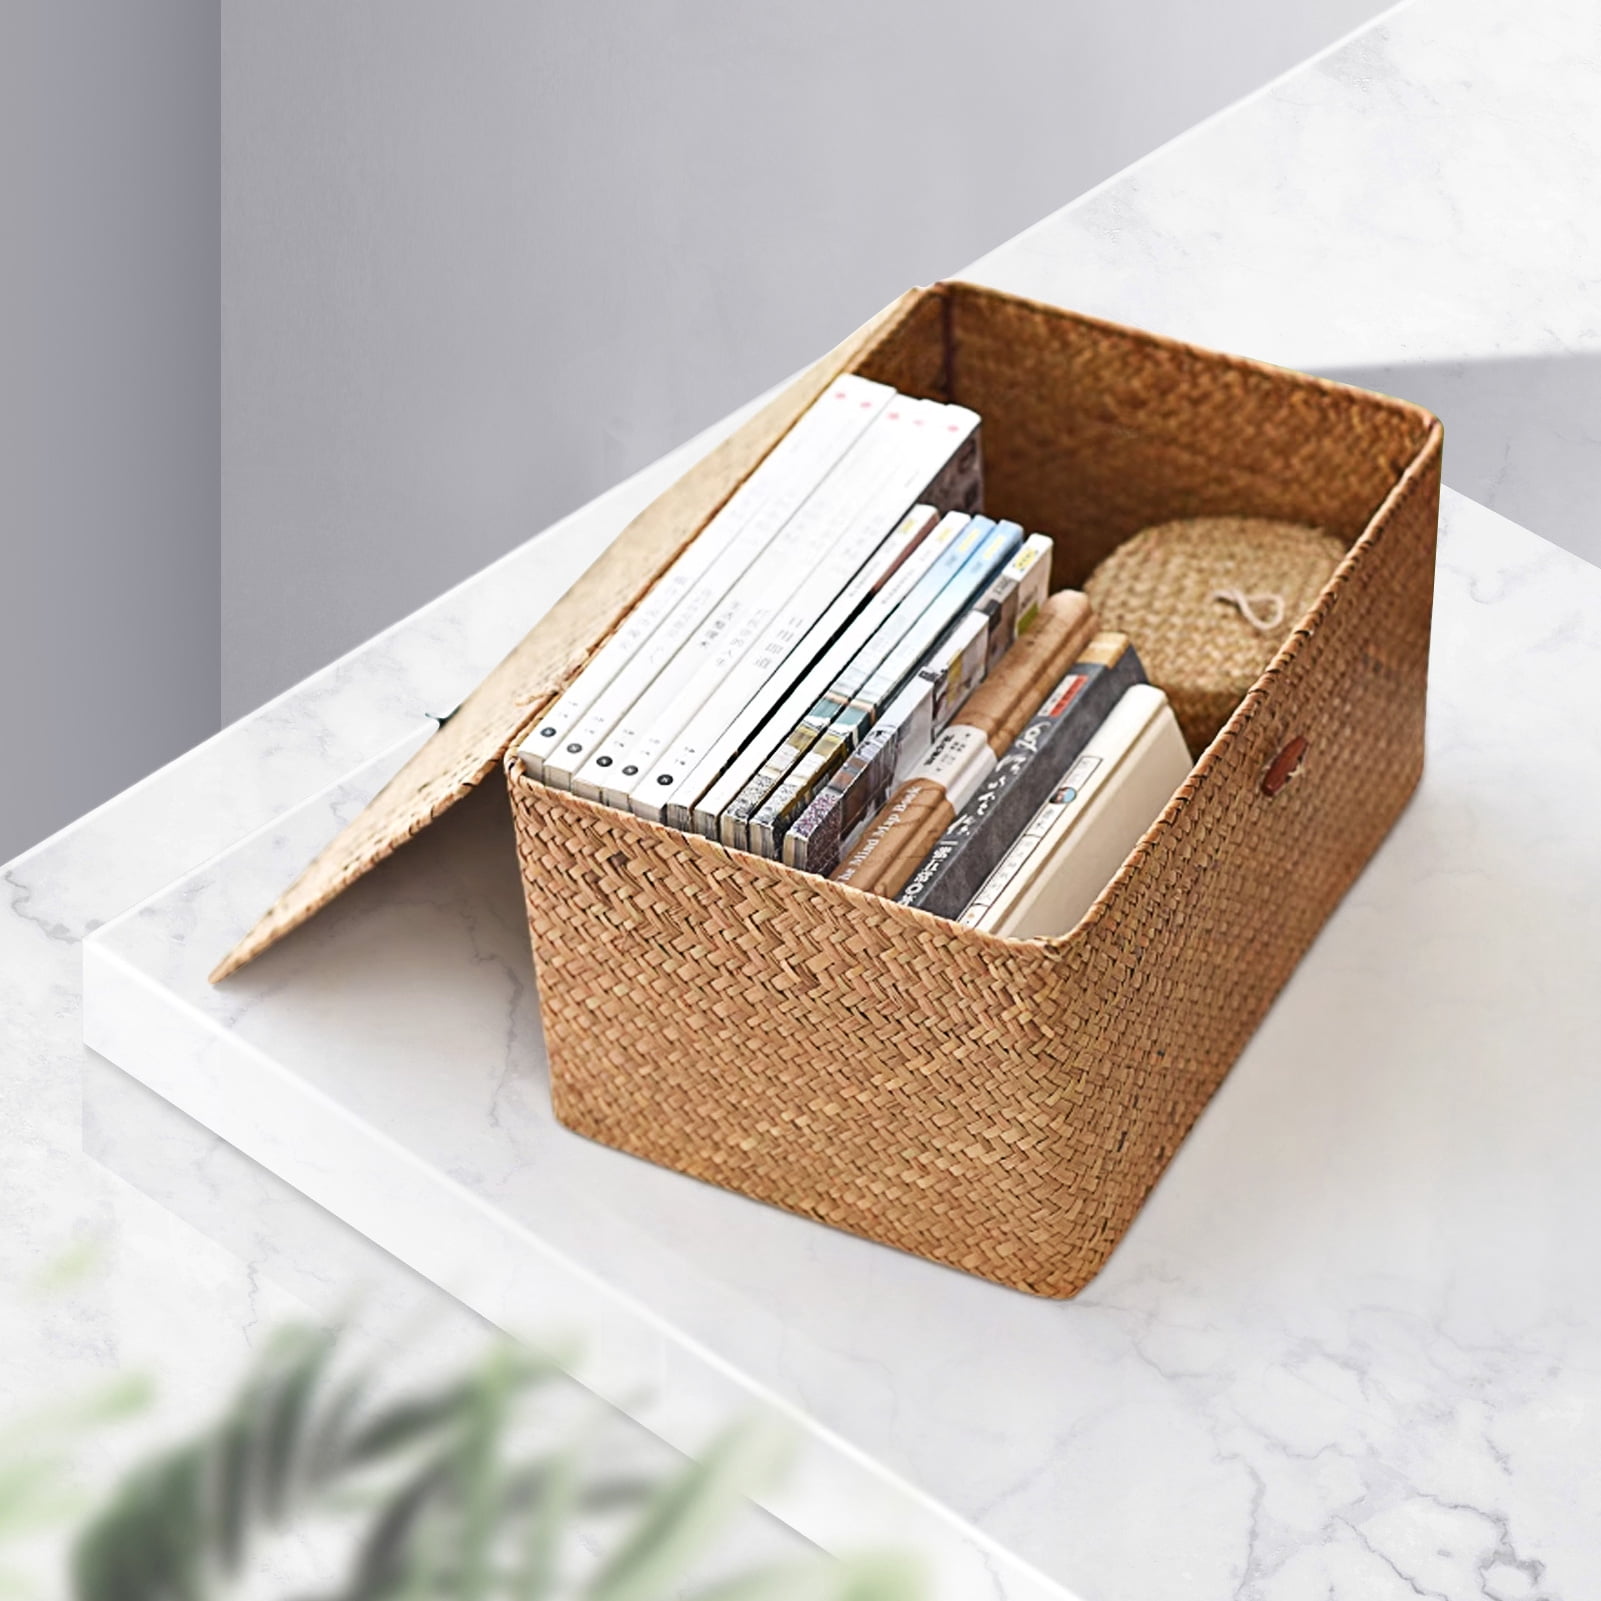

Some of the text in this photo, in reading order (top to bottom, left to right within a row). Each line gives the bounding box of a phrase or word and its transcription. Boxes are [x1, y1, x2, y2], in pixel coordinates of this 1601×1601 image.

[838, 785, 922, 881] he Mind Map Book
